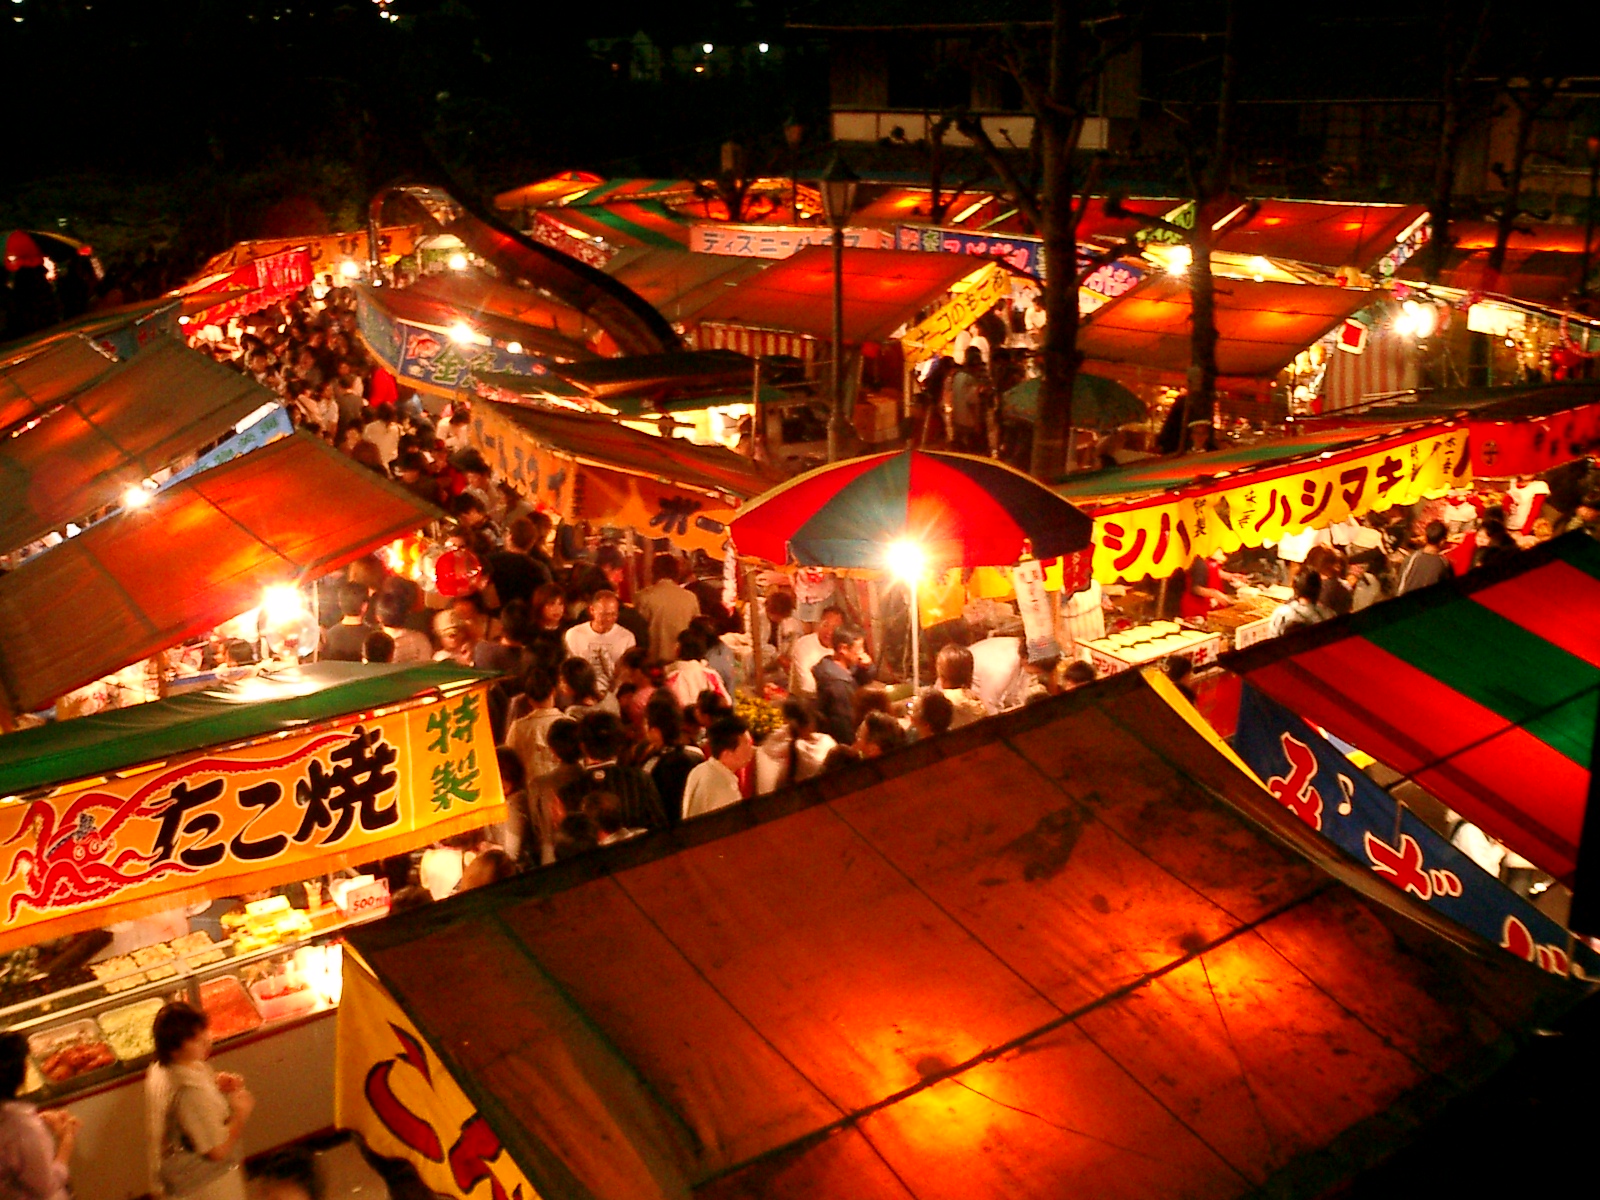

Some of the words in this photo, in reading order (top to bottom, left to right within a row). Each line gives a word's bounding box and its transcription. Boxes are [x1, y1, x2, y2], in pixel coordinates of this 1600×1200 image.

[1255, 456, 1403, 532] ハシマキ
[149, 724, 399, 866] たこ焼
[427, 696, 482, 812] 特製
